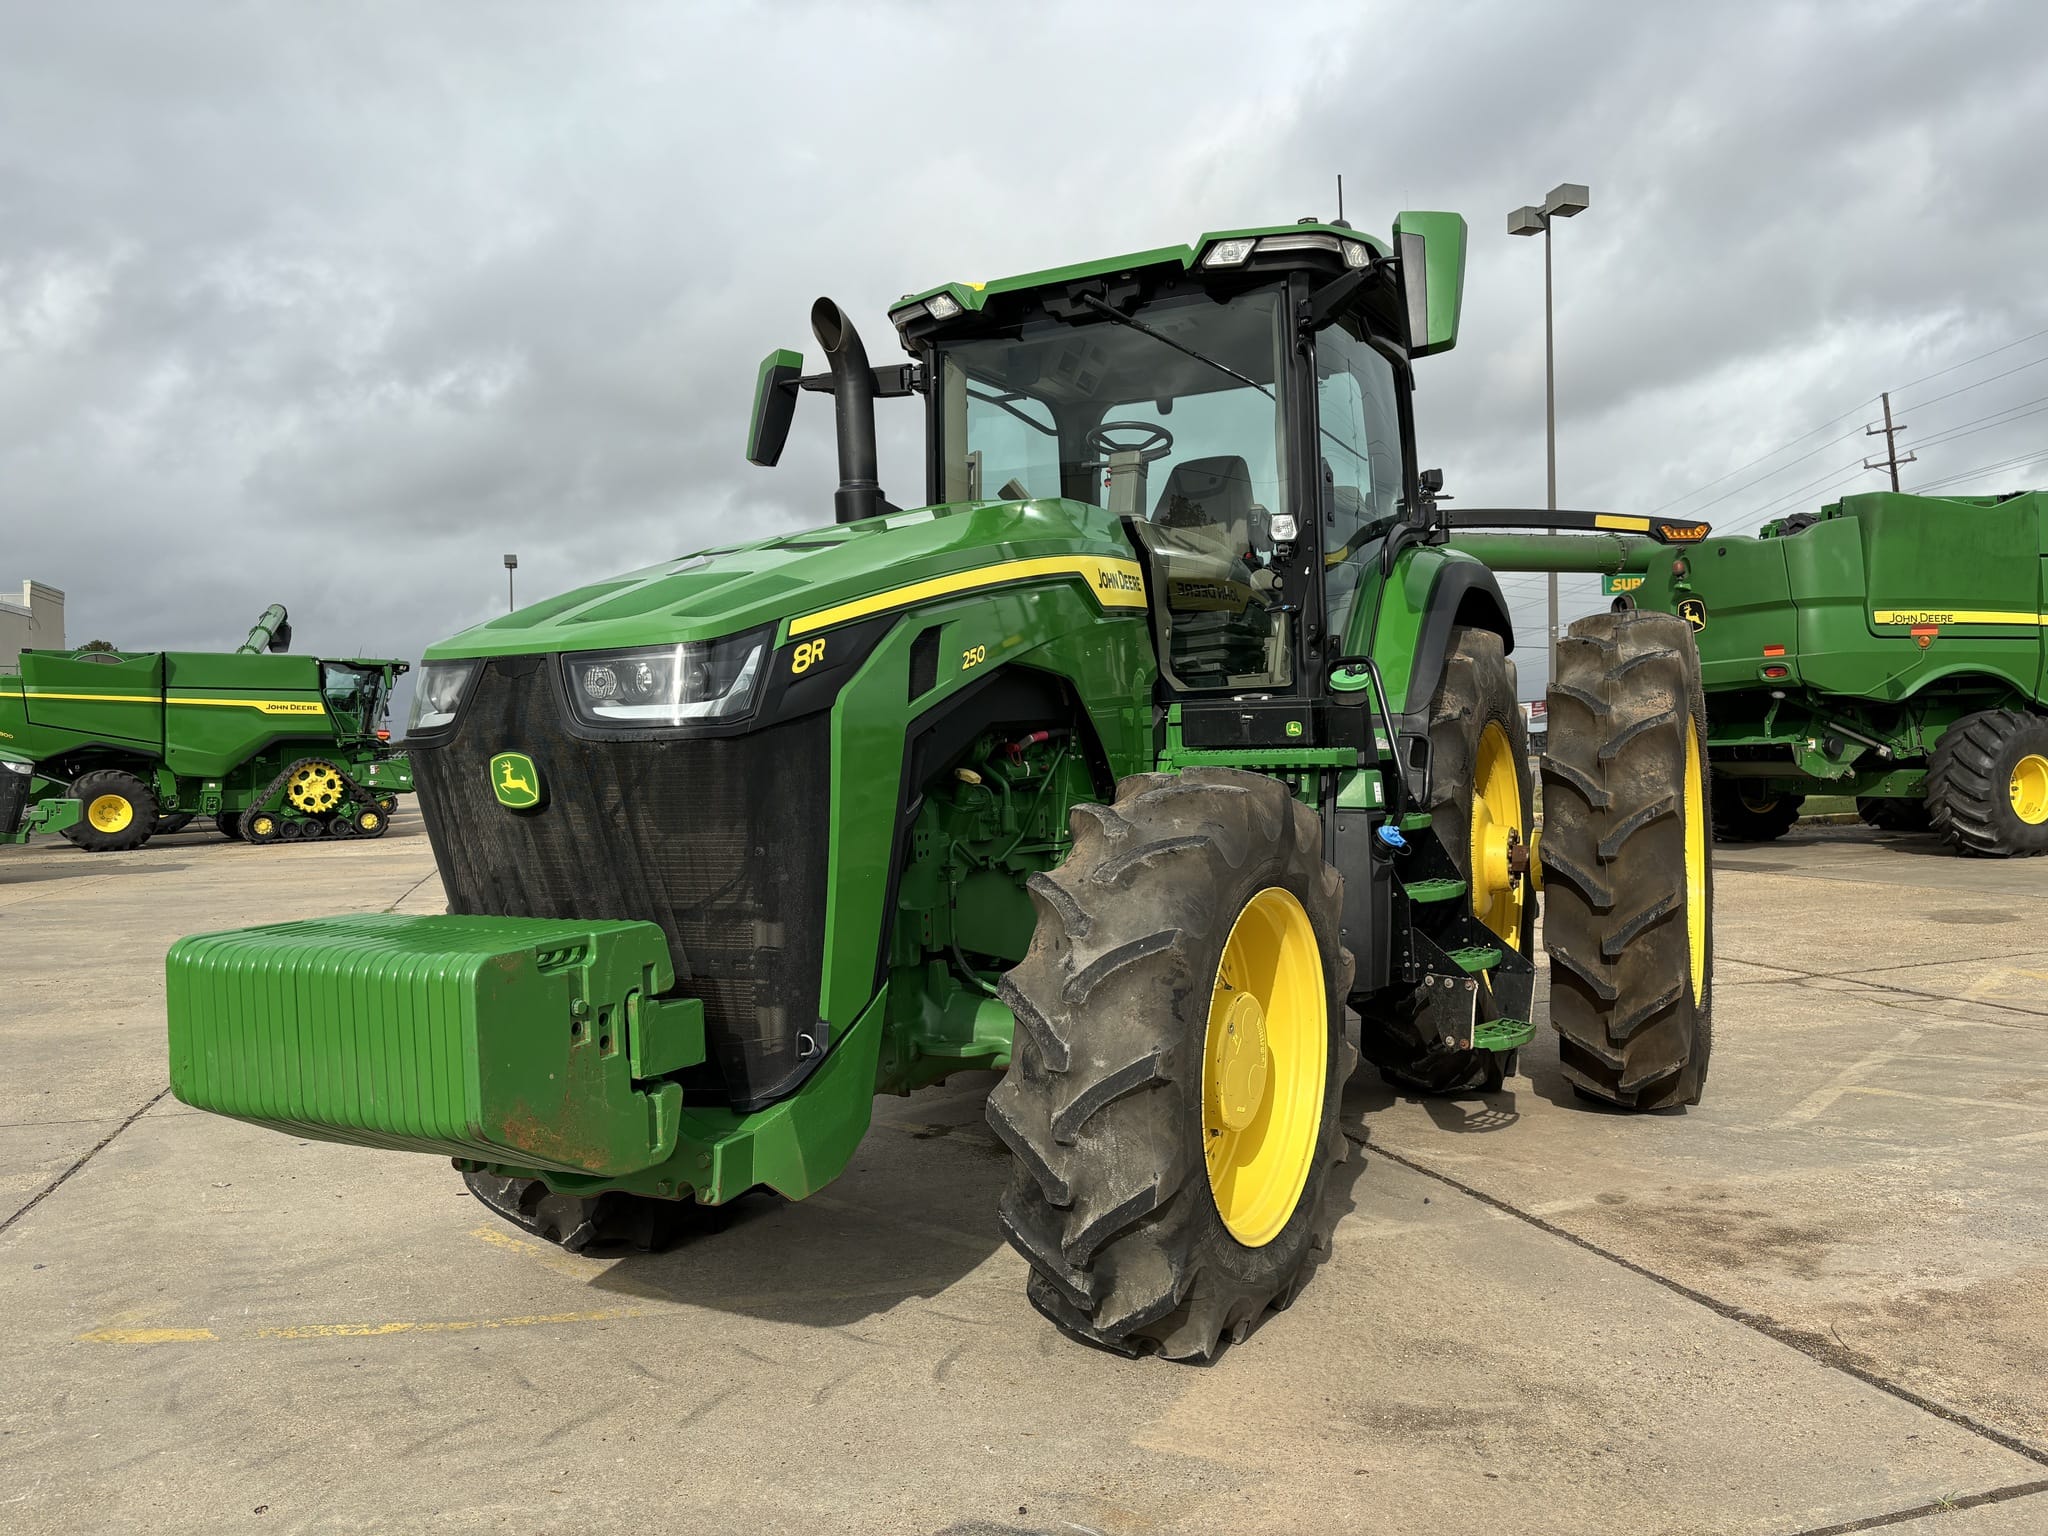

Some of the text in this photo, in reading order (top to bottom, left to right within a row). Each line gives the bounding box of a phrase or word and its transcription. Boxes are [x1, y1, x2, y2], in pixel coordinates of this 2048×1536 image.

[1097, 568, 1142, 592] JOHN DEERE
[1610, 577, 1645, 592] SUB
[1889, 612, 1954, 623] JOHN DEERE
[791, 637, 826, 674] 8R
[962, 645, 986, 670] 250
[265, 703, 319, 711] JOHN DEERE
